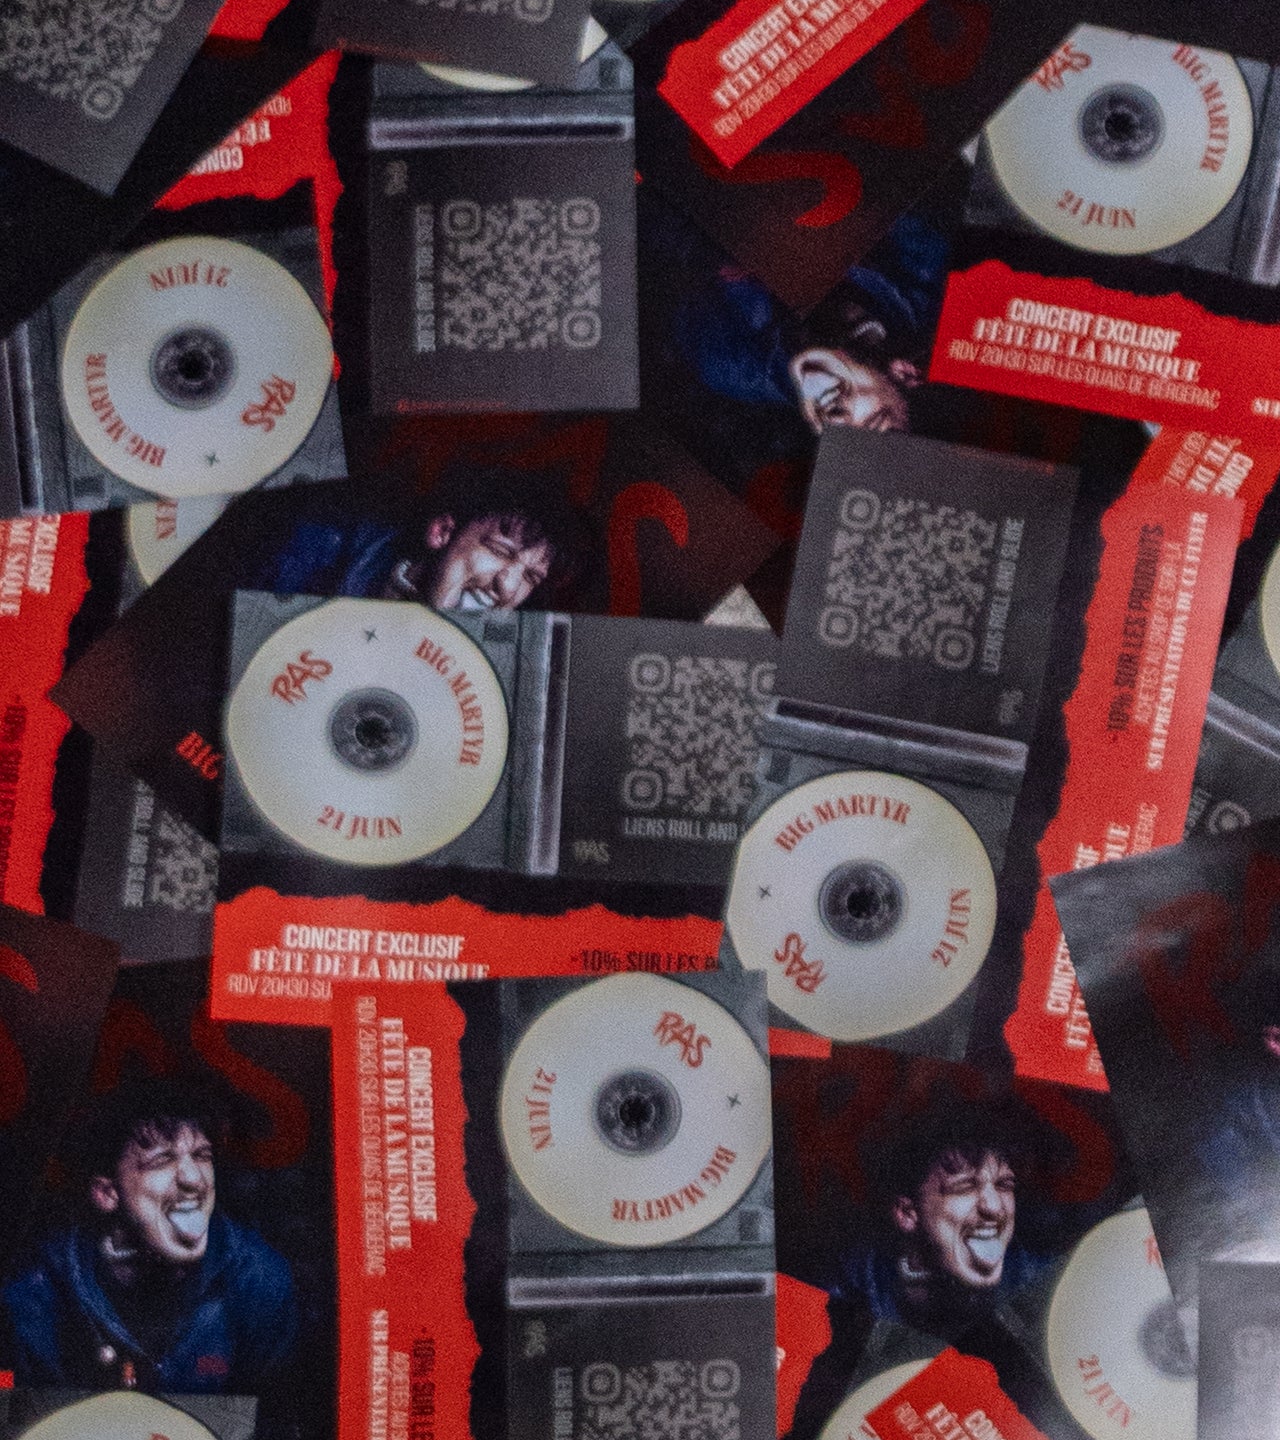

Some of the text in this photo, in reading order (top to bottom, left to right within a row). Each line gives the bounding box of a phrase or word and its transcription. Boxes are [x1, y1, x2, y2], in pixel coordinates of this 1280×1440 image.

[148, 261, 229, 290] 21 JUIN
[1004, 295, 1183, 356] CONCERT EXCLUSIF
[1032, 329, 1060, 354] DE
[1065, 336, 1098, 362] LA
[1098, 343, 1202, 385] MUSIQUE
[83, 353, 167, 469] BIG MARTYR
[239, 375, 297, 434] RAS
[268, 649, 334, 705] RAS
[413, 636, 485, 767] BIG MARTYR
[316, 805, 403, 840] 21 JUIN
[773, 793, 911, 853] BIG MARTYR
[282, 922, 465, 960] CONCERT EXCLUSIF
[930, 887, 971, 968] 21 JUIN
[225, 972, 309, 998] RDV 20H30
[313, 952, 344, 977] DE
[351, 955, 382, 979] LA
[385, 958, 490, 985] MUSIQUE
[772, 931, 826, 996] RAS
[652, 1009, 712, 1070] RAS
[523, 1068, 557, 1153] 21 JUIN
[610, 1144, 737, 1223] BIG MARTYR
